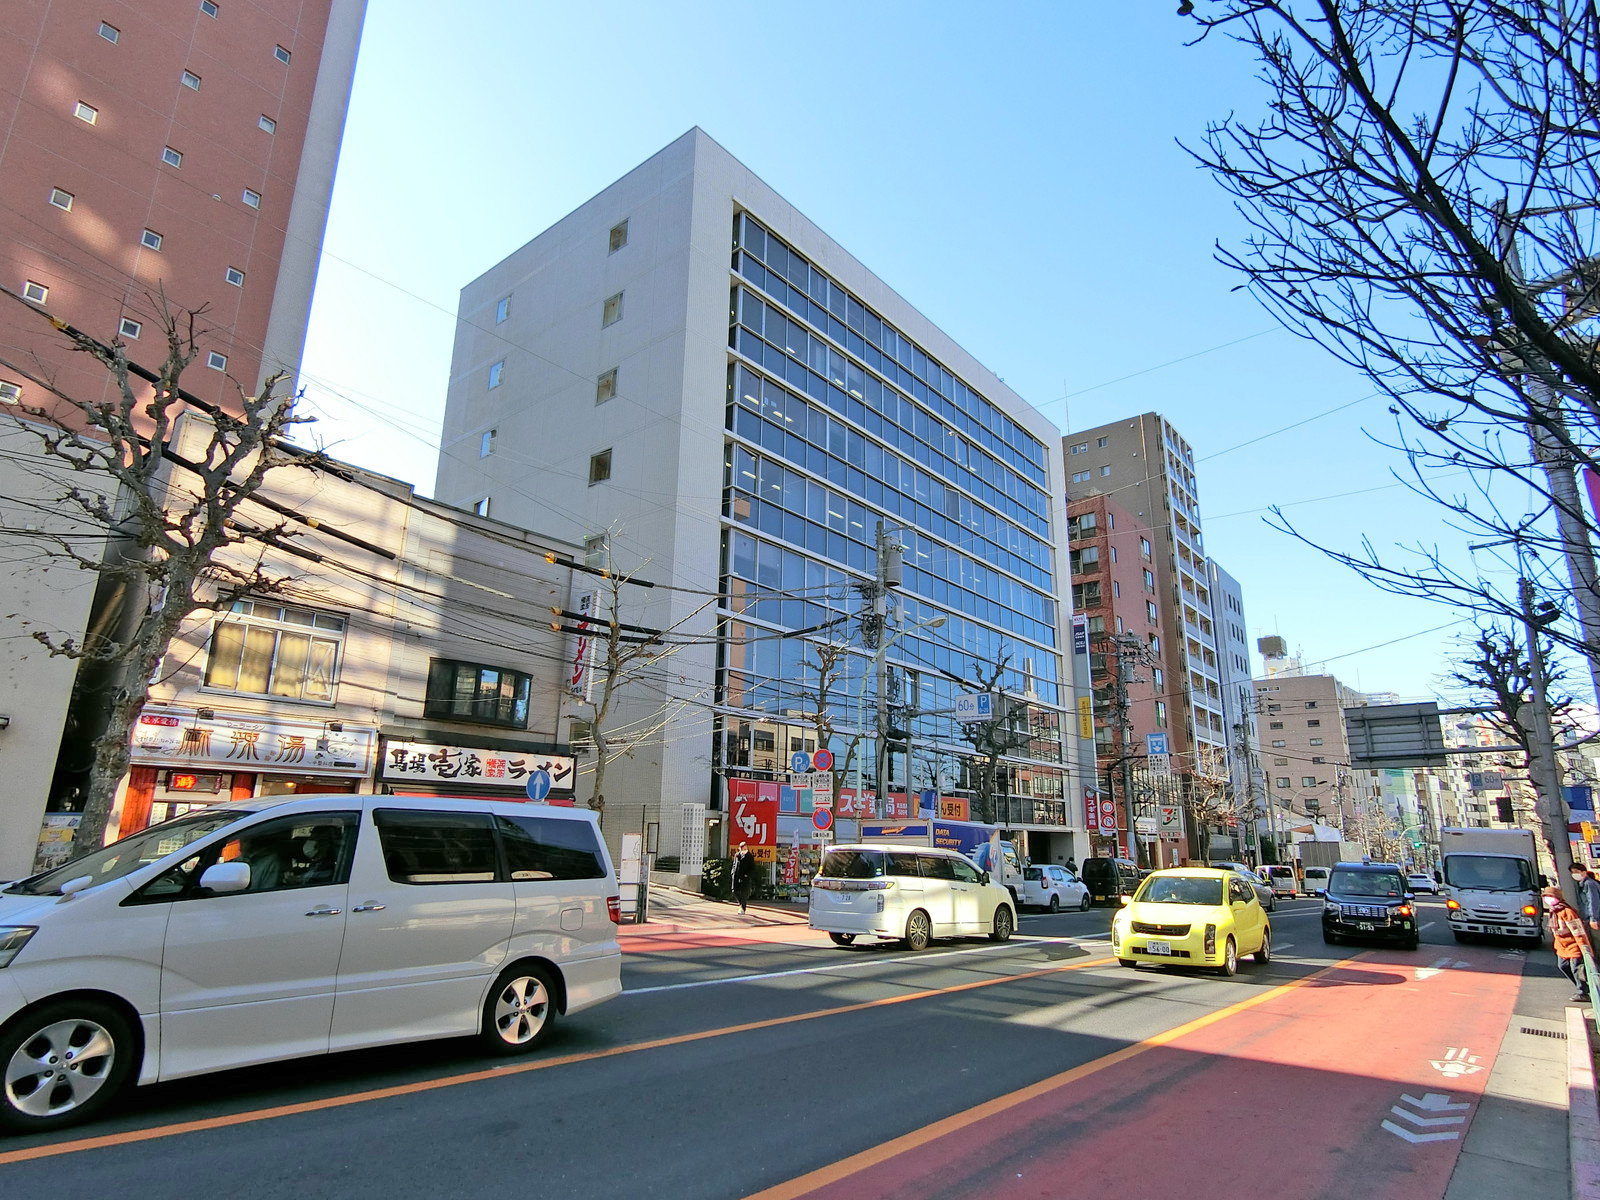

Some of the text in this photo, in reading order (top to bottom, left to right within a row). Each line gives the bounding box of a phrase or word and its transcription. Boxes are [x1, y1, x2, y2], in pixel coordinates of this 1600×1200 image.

[980, 696, 987, 707] P
[795, 756, 803, 770] P
[735, 803, 767, 845] くすり
[935, 829, 950, 837] DATA
[935, 838, 962, 847] SECURITY
